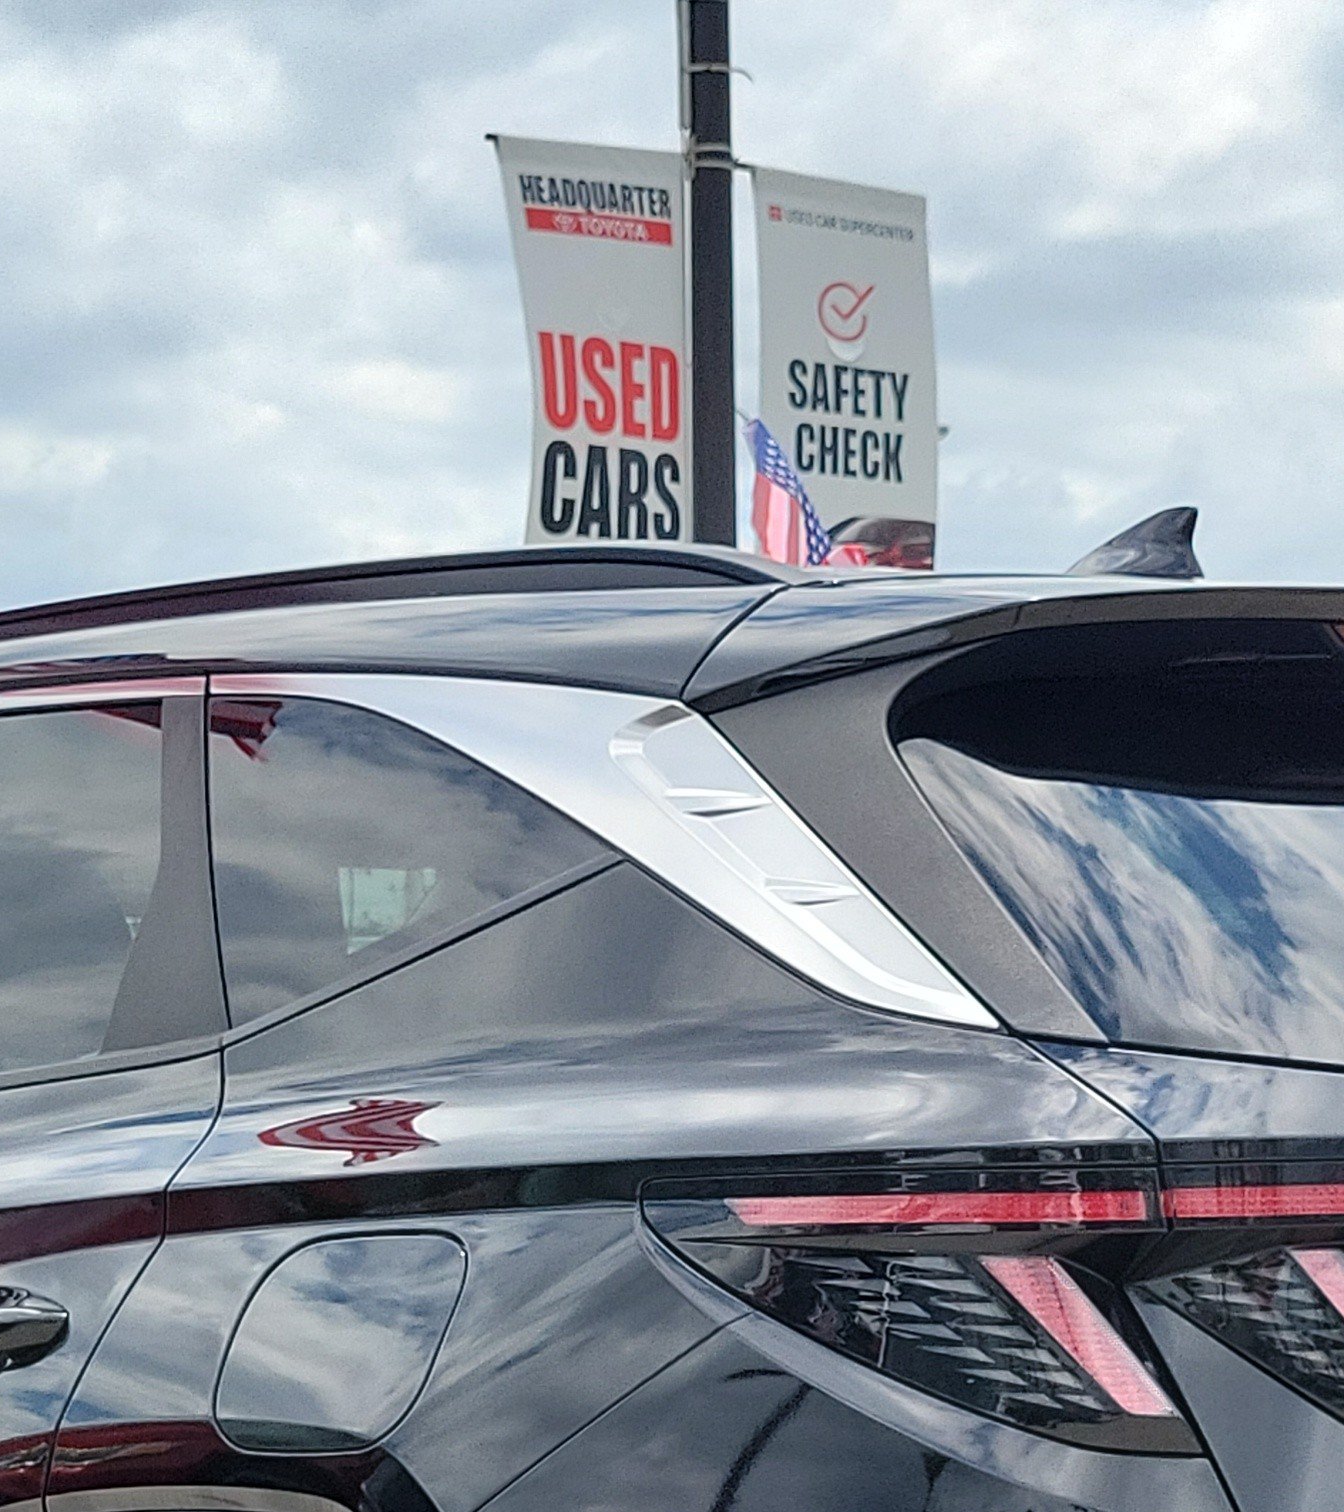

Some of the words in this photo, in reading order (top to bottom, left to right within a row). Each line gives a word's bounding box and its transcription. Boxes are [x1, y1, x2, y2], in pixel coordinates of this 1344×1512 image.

[519, 174, 672, 218] HEADQUARTER
[579, 217, 649, 242] TOYOTA
[537, 331, 681, 443] USED
[788, 359, 909, 422] SAFETY
[794, 423, 904, 483] CHECK
[540, 440, 681, 541] CARS
